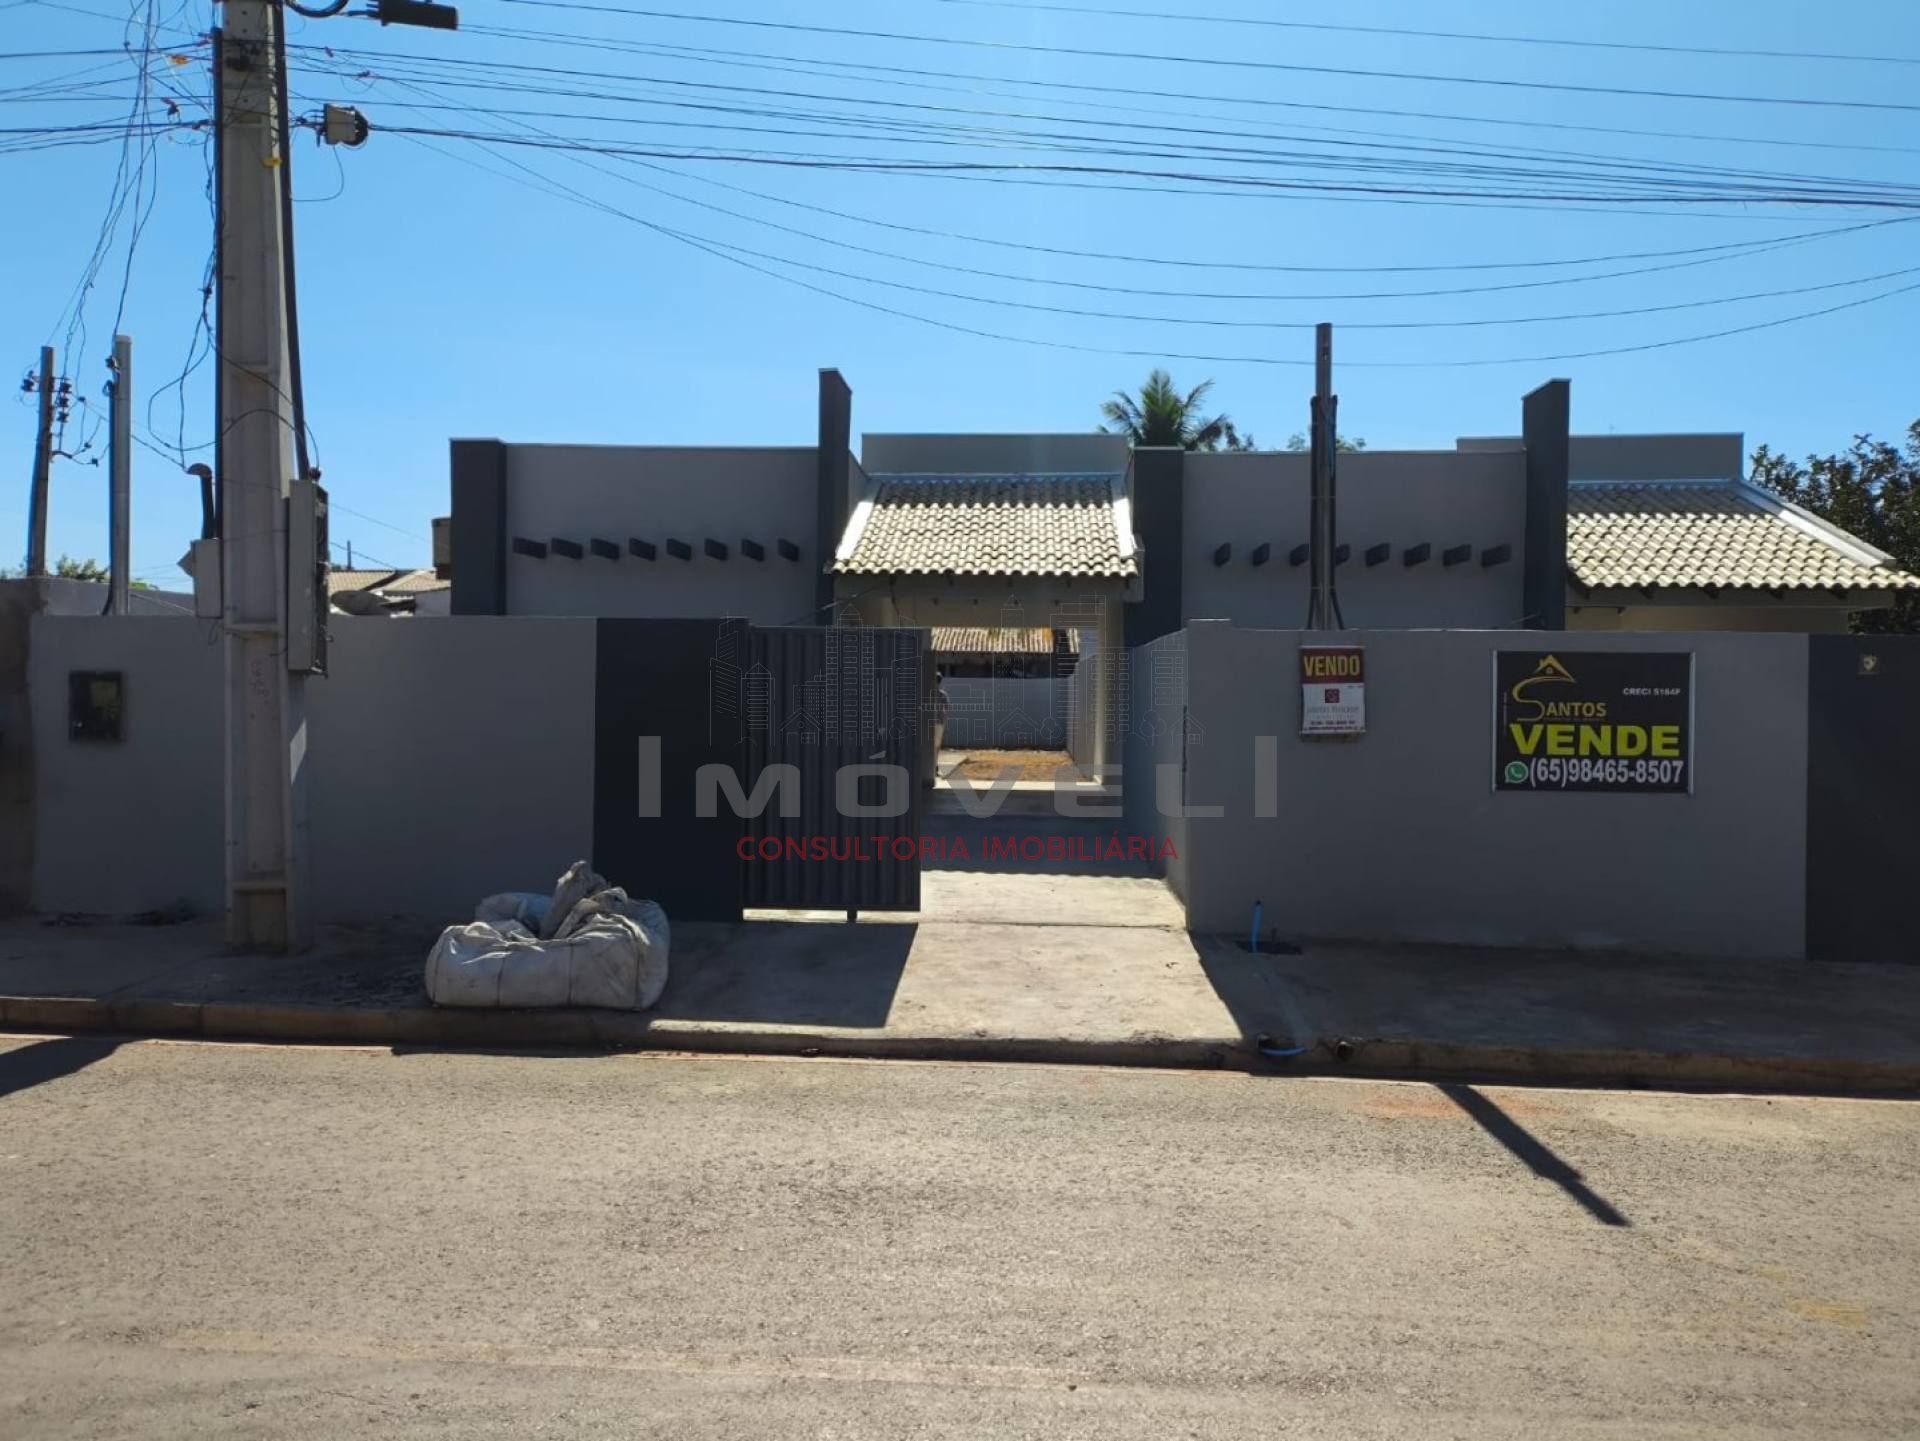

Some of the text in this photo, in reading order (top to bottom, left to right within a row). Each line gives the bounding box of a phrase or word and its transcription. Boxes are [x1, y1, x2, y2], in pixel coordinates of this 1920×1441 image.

[1303, 655, 1361, 677] VENDO
[1623, 687, 1651, 696] CRECI
[1509, 723, 1680, 756] VENDE
[1530, 757, 1684, 788] (65)98465-8507
